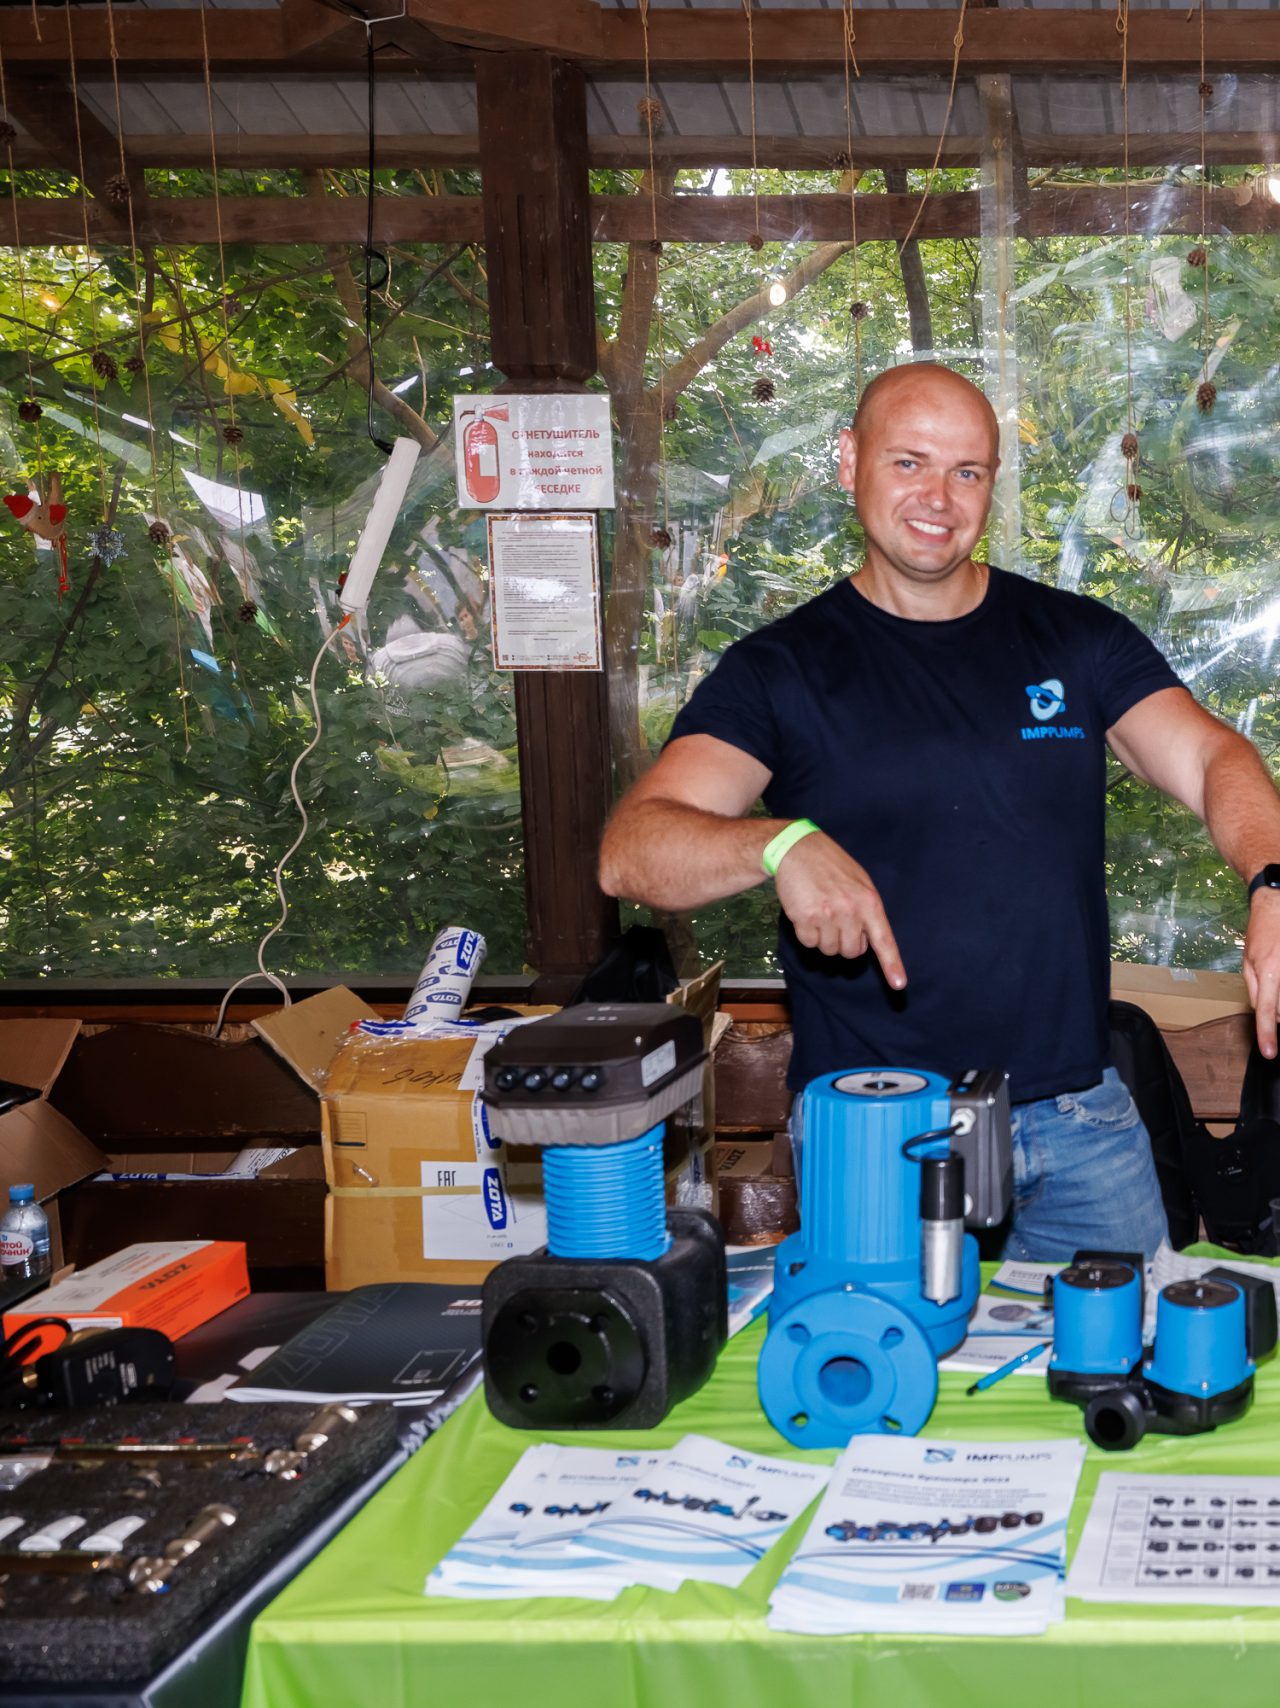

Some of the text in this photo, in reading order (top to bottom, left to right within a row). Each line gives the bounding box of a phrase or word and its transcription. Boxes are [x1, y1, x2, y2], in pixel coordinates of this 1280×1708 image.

[512, 429, 600, 440] ОНЕТУШИТЕЛЬ
[510, 467, 516, 476] в
[431, 994, 460, 1003] ZOTA
[487, 1175, 504, 1223] ZOTA
